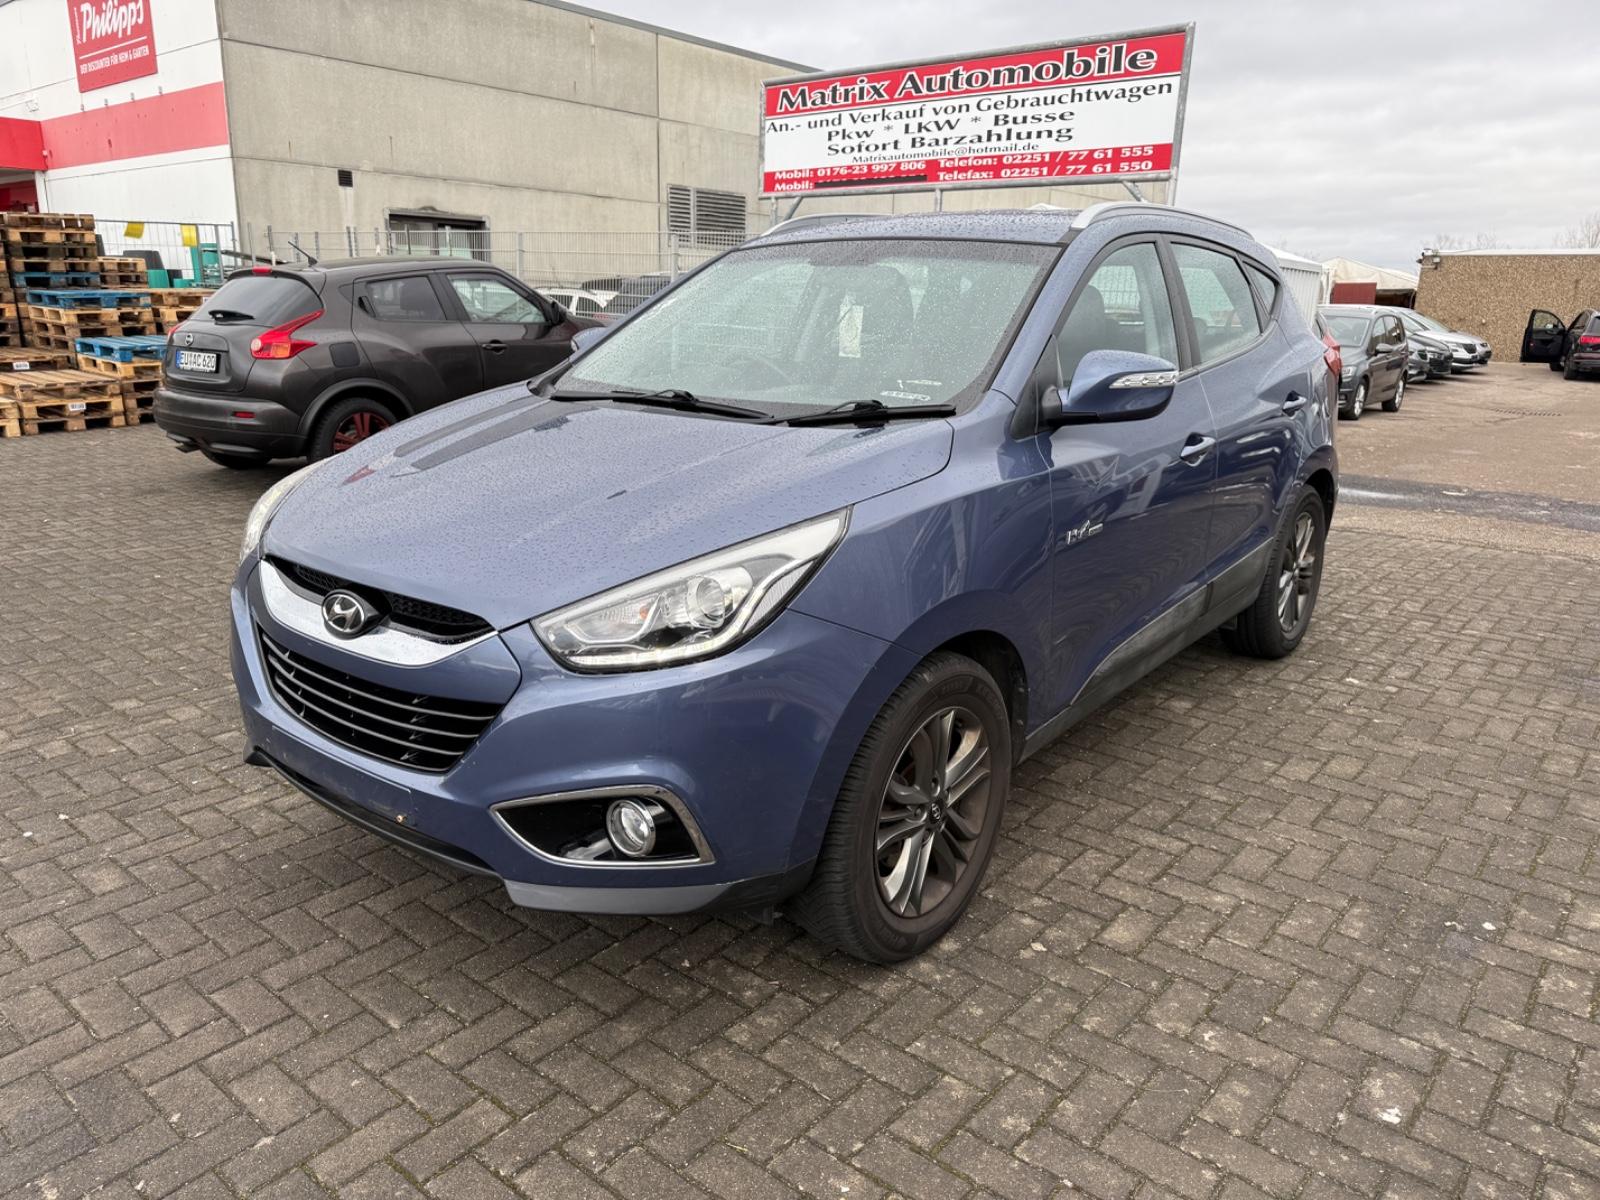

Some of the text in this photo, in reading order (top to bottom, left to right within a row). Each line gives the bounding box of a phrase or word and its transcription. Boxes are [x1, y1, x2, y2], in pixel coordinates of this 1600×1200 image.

[80, 0, 144, 43] Philipps
[776, 43, 1158, 113] Matrix Automobile
[807, 114, 842, 129] und
[849, 104, 926, 127] Verkauf
[932, 102, 970, 116] von
[976, 82, 1173, 113] Gebrauchtwagen
[827, 110, 1075, 141] Pkw LKW Busse
[827, 127, 1074, 156] Sofort Barzahlung
[852, 143, 1039, 163] Matrixautomobile@hotmail.de
[938, 154, 997, 168] Telefon:
[1002, 152, 1050, 165] 02251
[1068, 151, 1089, 162] 77
[1093, 149, 1113, 159] 61
[1120, 146, 1154, 157] 555
[774, 161, 926, 181] Mobil: 0176-23 997 806
[937, 169, 994, 181] Telefax:
[1001, 167, 1048, 178] 02251
[1066, 165, 1087, 175] 77
[1092, 163, 1111, 173] 61
[1119, 161, 1153, 172] 550
[773, 181, 814, 192] Mobil:
[180, 352, 189, 366] EU
[203, 355, 216, 369] 620
